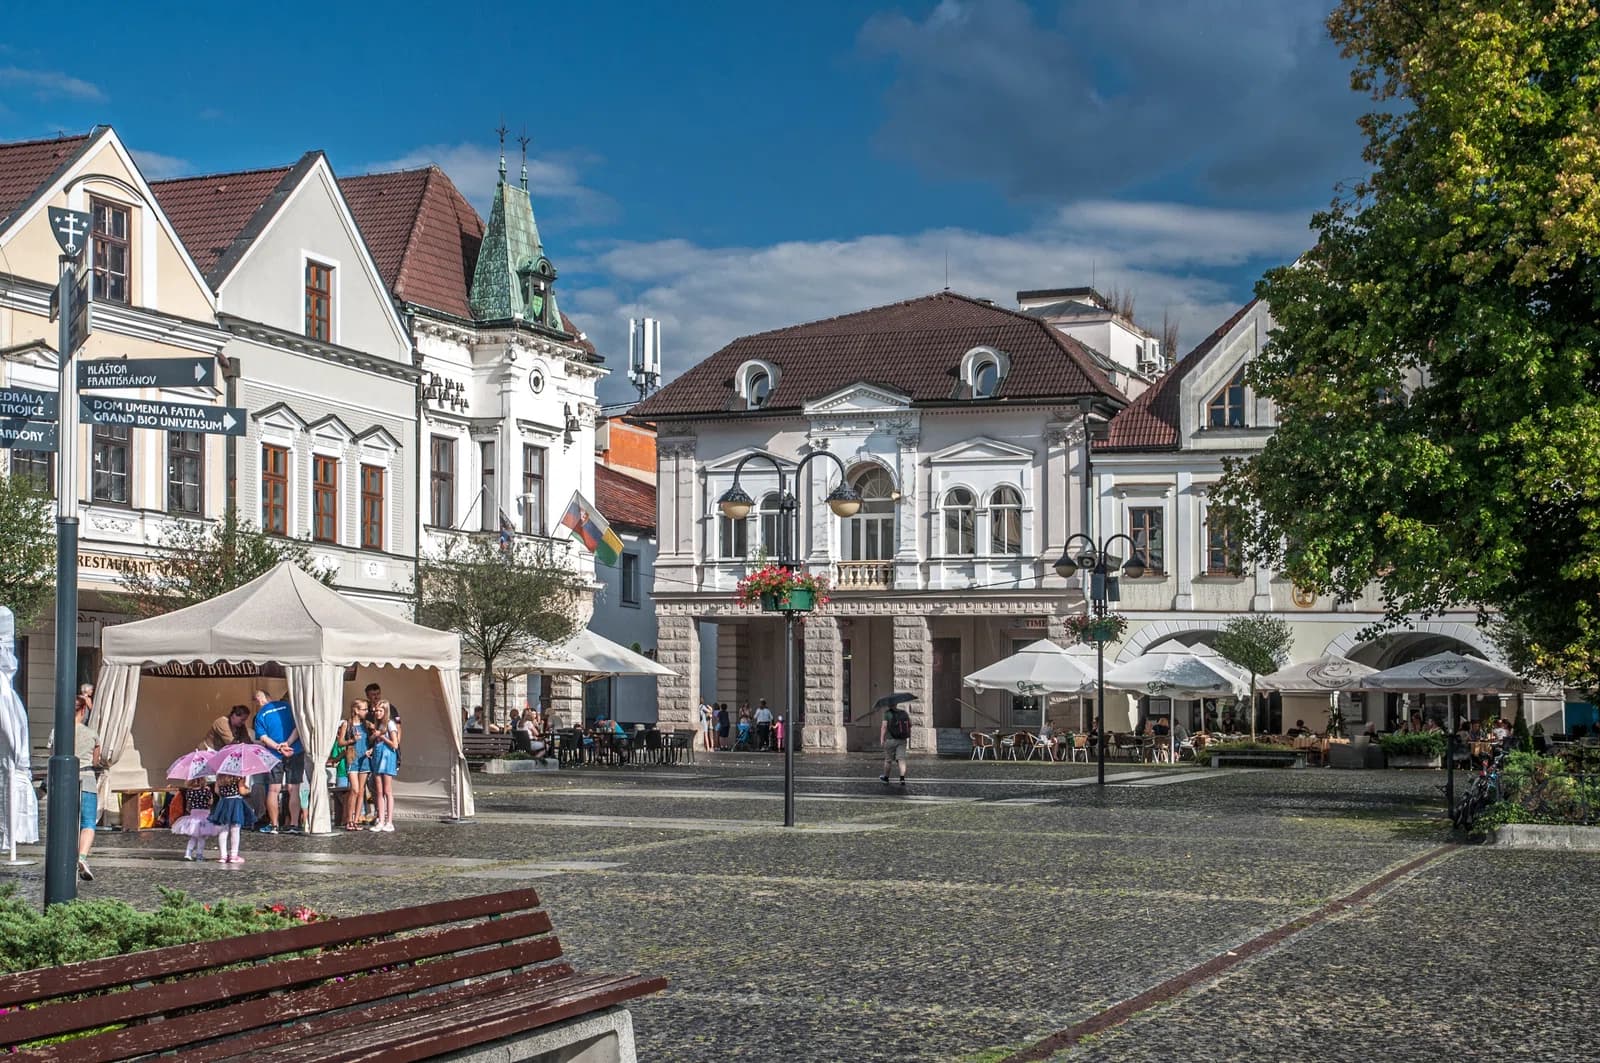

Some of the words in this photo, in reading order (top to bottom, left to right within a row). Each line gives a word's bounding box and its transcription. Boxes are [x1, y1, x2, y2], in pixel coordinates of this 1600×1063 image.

[87, 362, 128, 375] KLÁŠTOR
[87, 373, 157, 386] FRANTIŠKÁNOV
[1, 403, 45, 417] TROJICE
[94, 400, 123, 411] DOM
[126, 403, 168, 415] UMENIA
[171, 406, 205, 418] FATRA
[93, 411, 135, 423] GRAND
[137, 415, 158, 425] BIO
[160, 416, 222, 431] UNIVERSUM
[77, 554, 152, 573] RESTAURANT
[197, 661, 206, 676] Z
